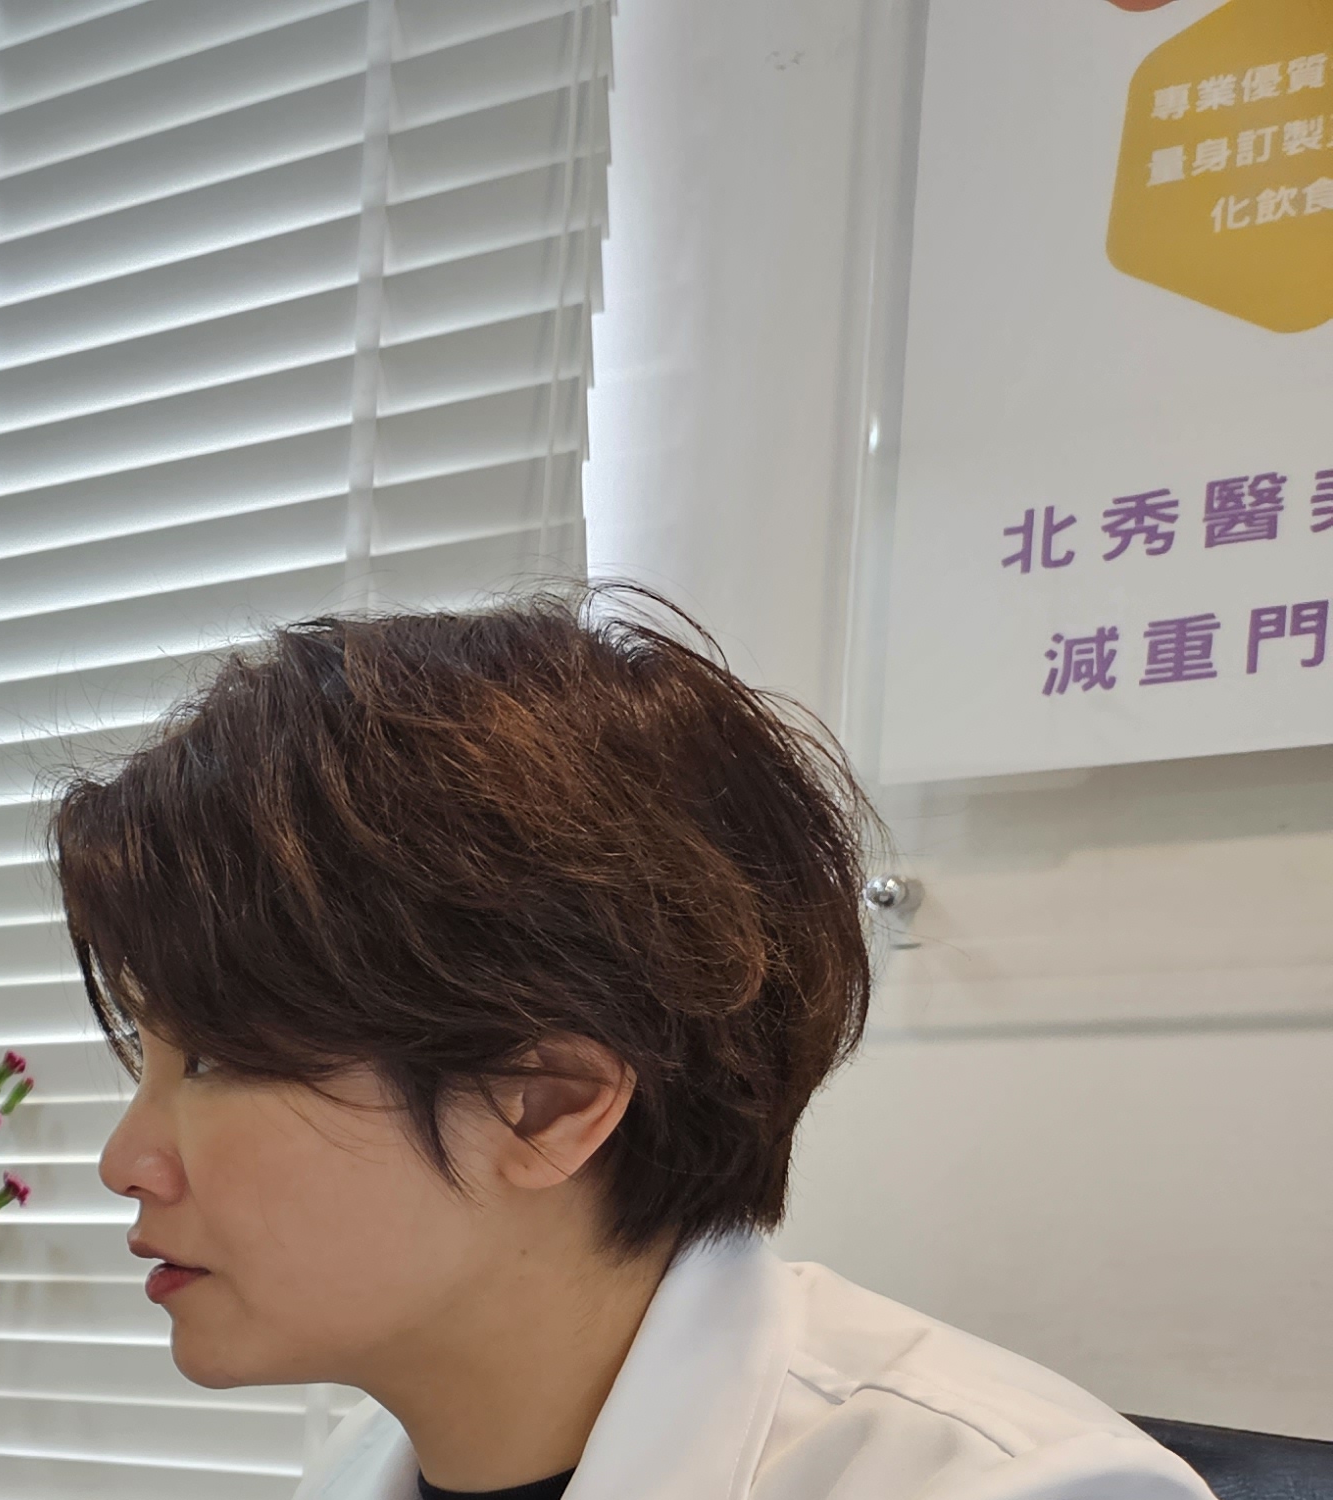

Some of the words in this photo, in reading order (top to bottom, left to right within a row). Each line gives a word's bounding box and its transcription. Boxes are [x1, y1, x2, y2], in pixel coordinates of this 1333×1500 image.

[1150, 52, 1328, 121] 專業優質
[1146, 114, 1333, 188] 量身訂製
[1042, 600, 1329, 696] 減重門
